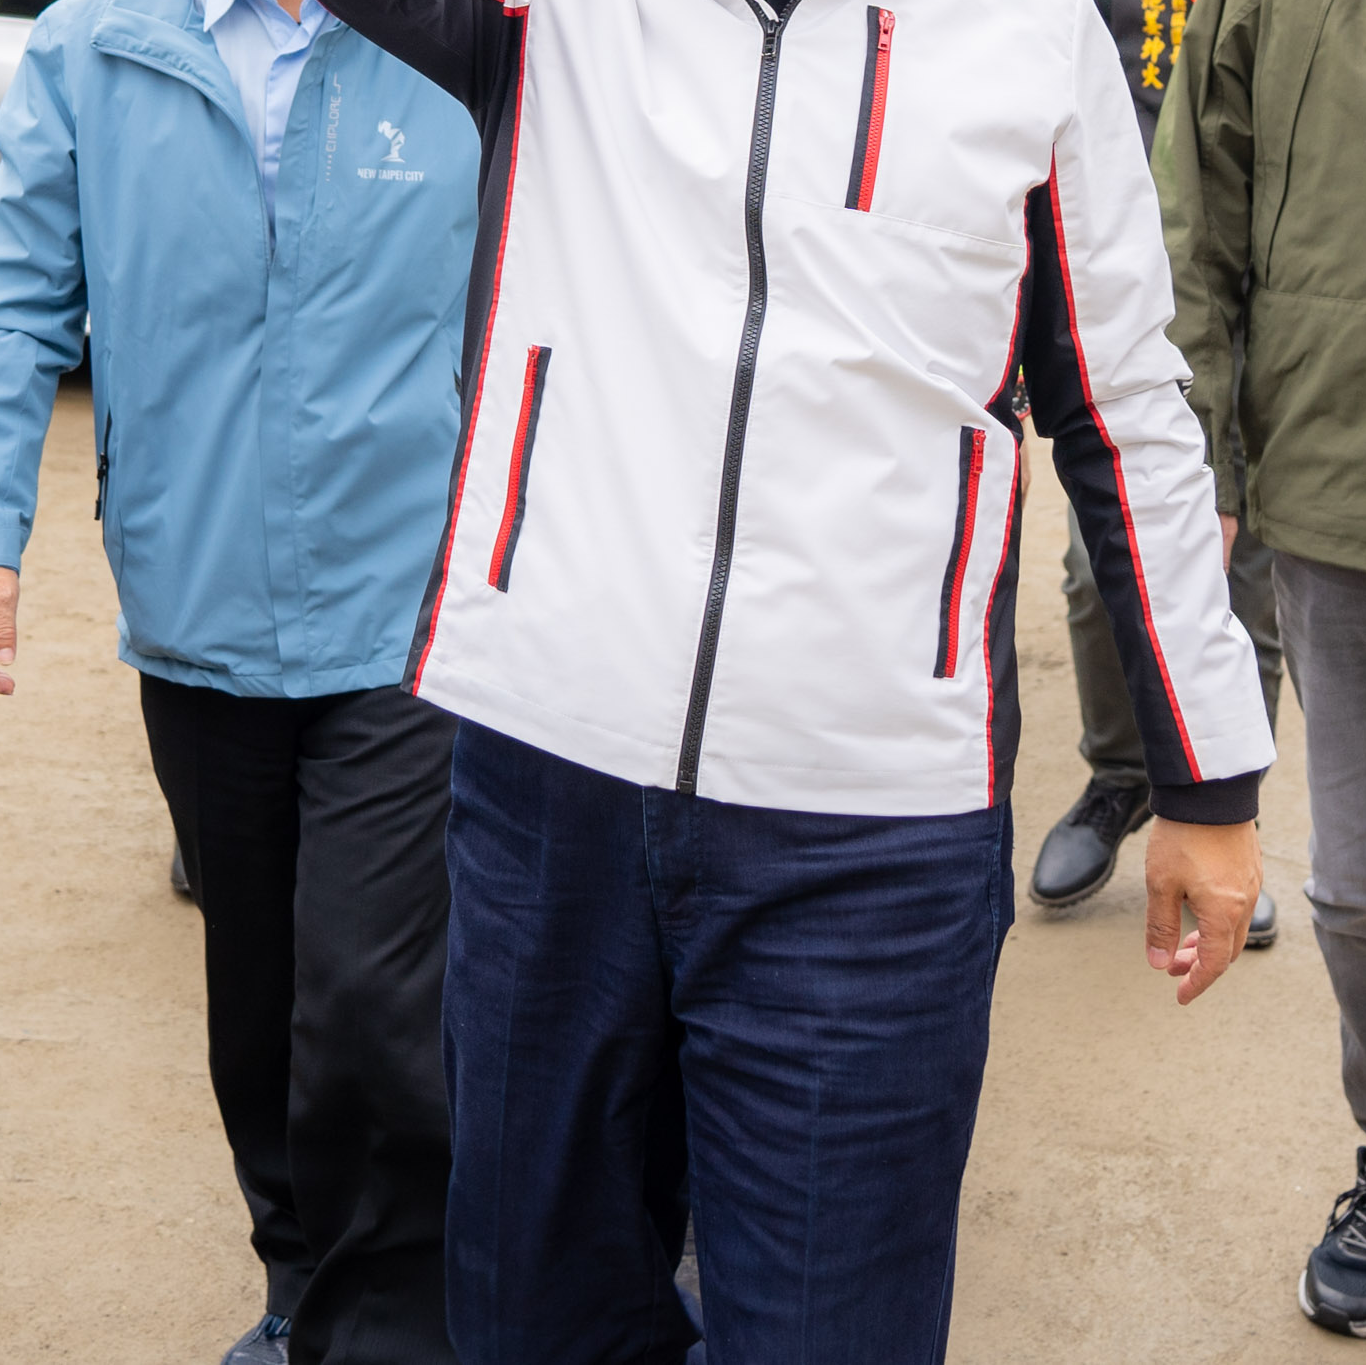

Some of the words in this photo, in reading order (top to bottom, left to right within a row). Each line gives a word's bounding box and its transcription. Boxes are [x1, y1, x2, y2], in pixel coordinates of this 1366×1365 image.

[357, 168, 376, 179] NEW
[378, 169, 403, 180] TAIPEI
[404, 171, 424, 182] CITY
